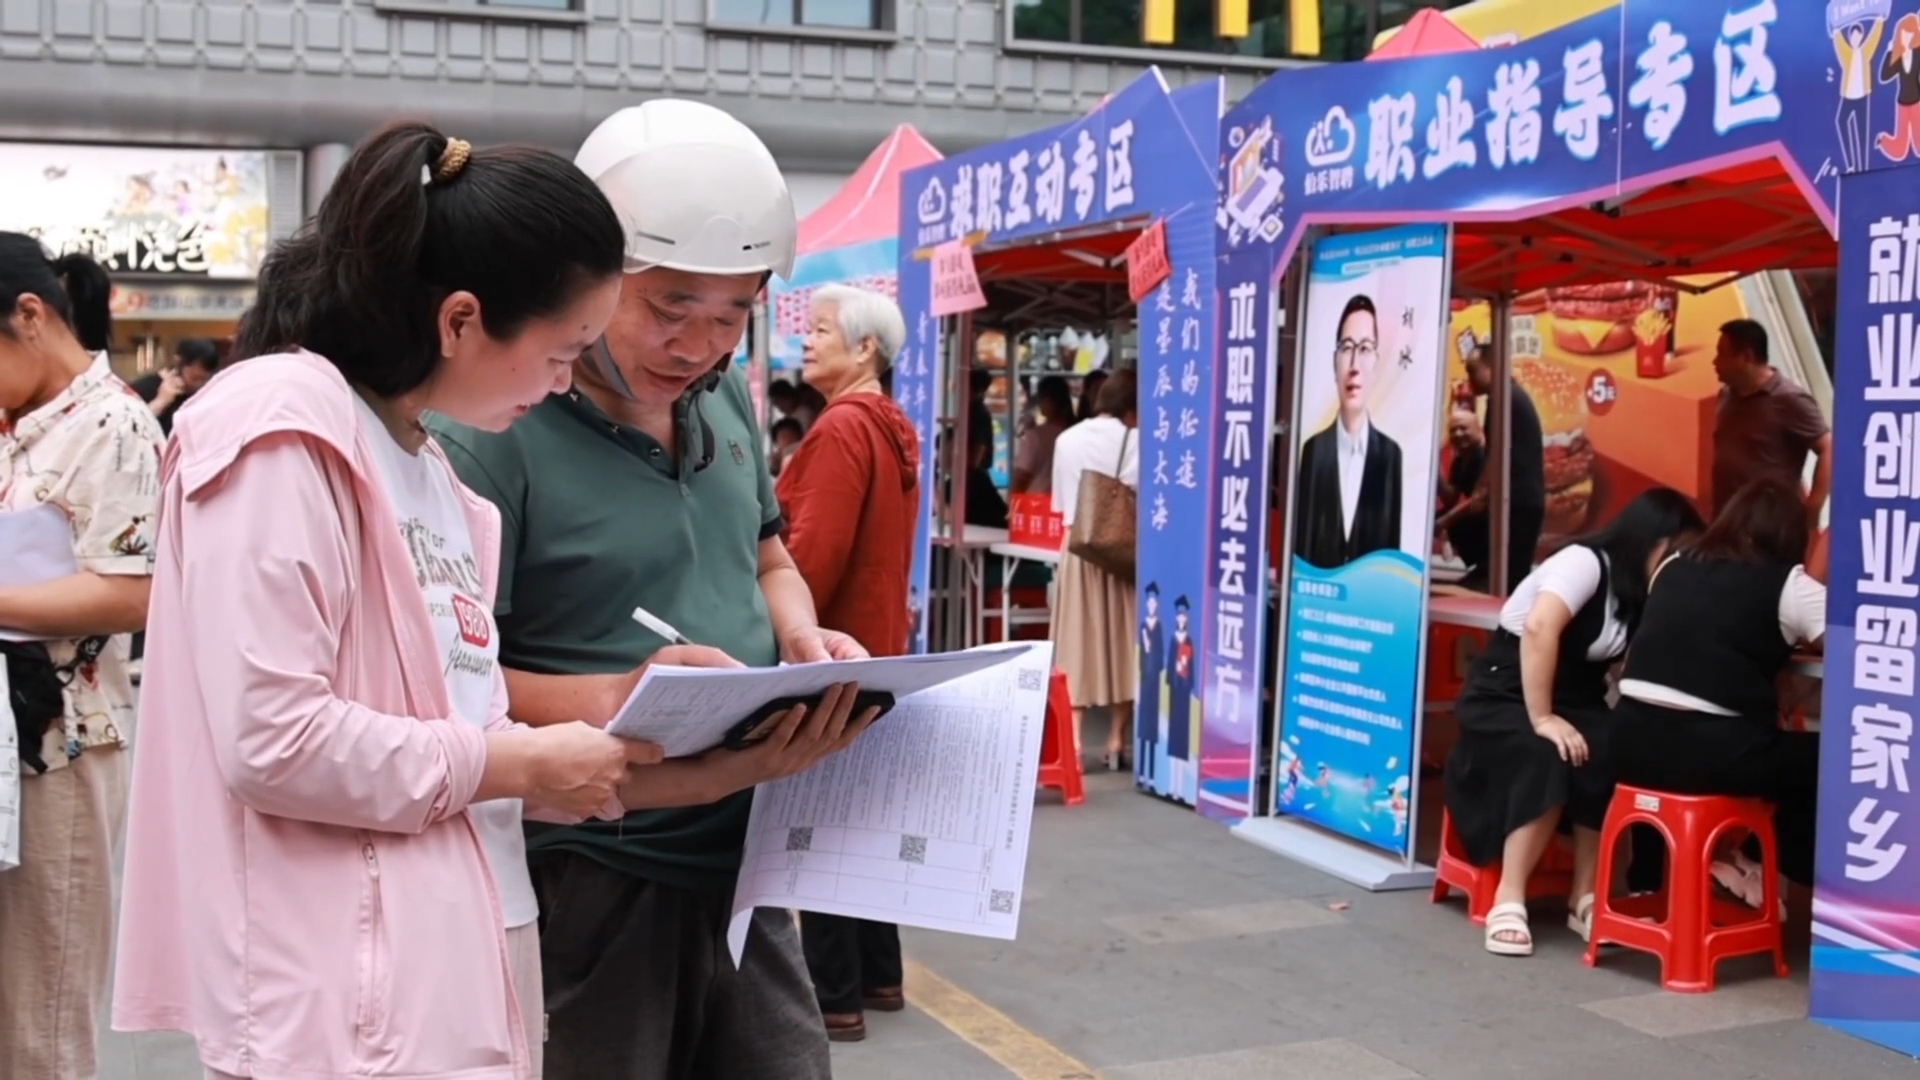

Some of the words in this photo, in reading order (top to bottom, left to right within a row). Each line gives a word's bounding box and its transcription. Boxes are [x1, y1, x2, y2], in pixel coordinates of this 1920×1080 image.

[950, 119, 1135, 238] 求职互动专区
[1364, 0, 1782, 190] 职业指导专区
[1175, 267, 1202, 489] 我们的征途
[1215, 281, 1256, 724] 求职不必去远方
[1845, 213, 1920, 883] 就业创业留家乡
